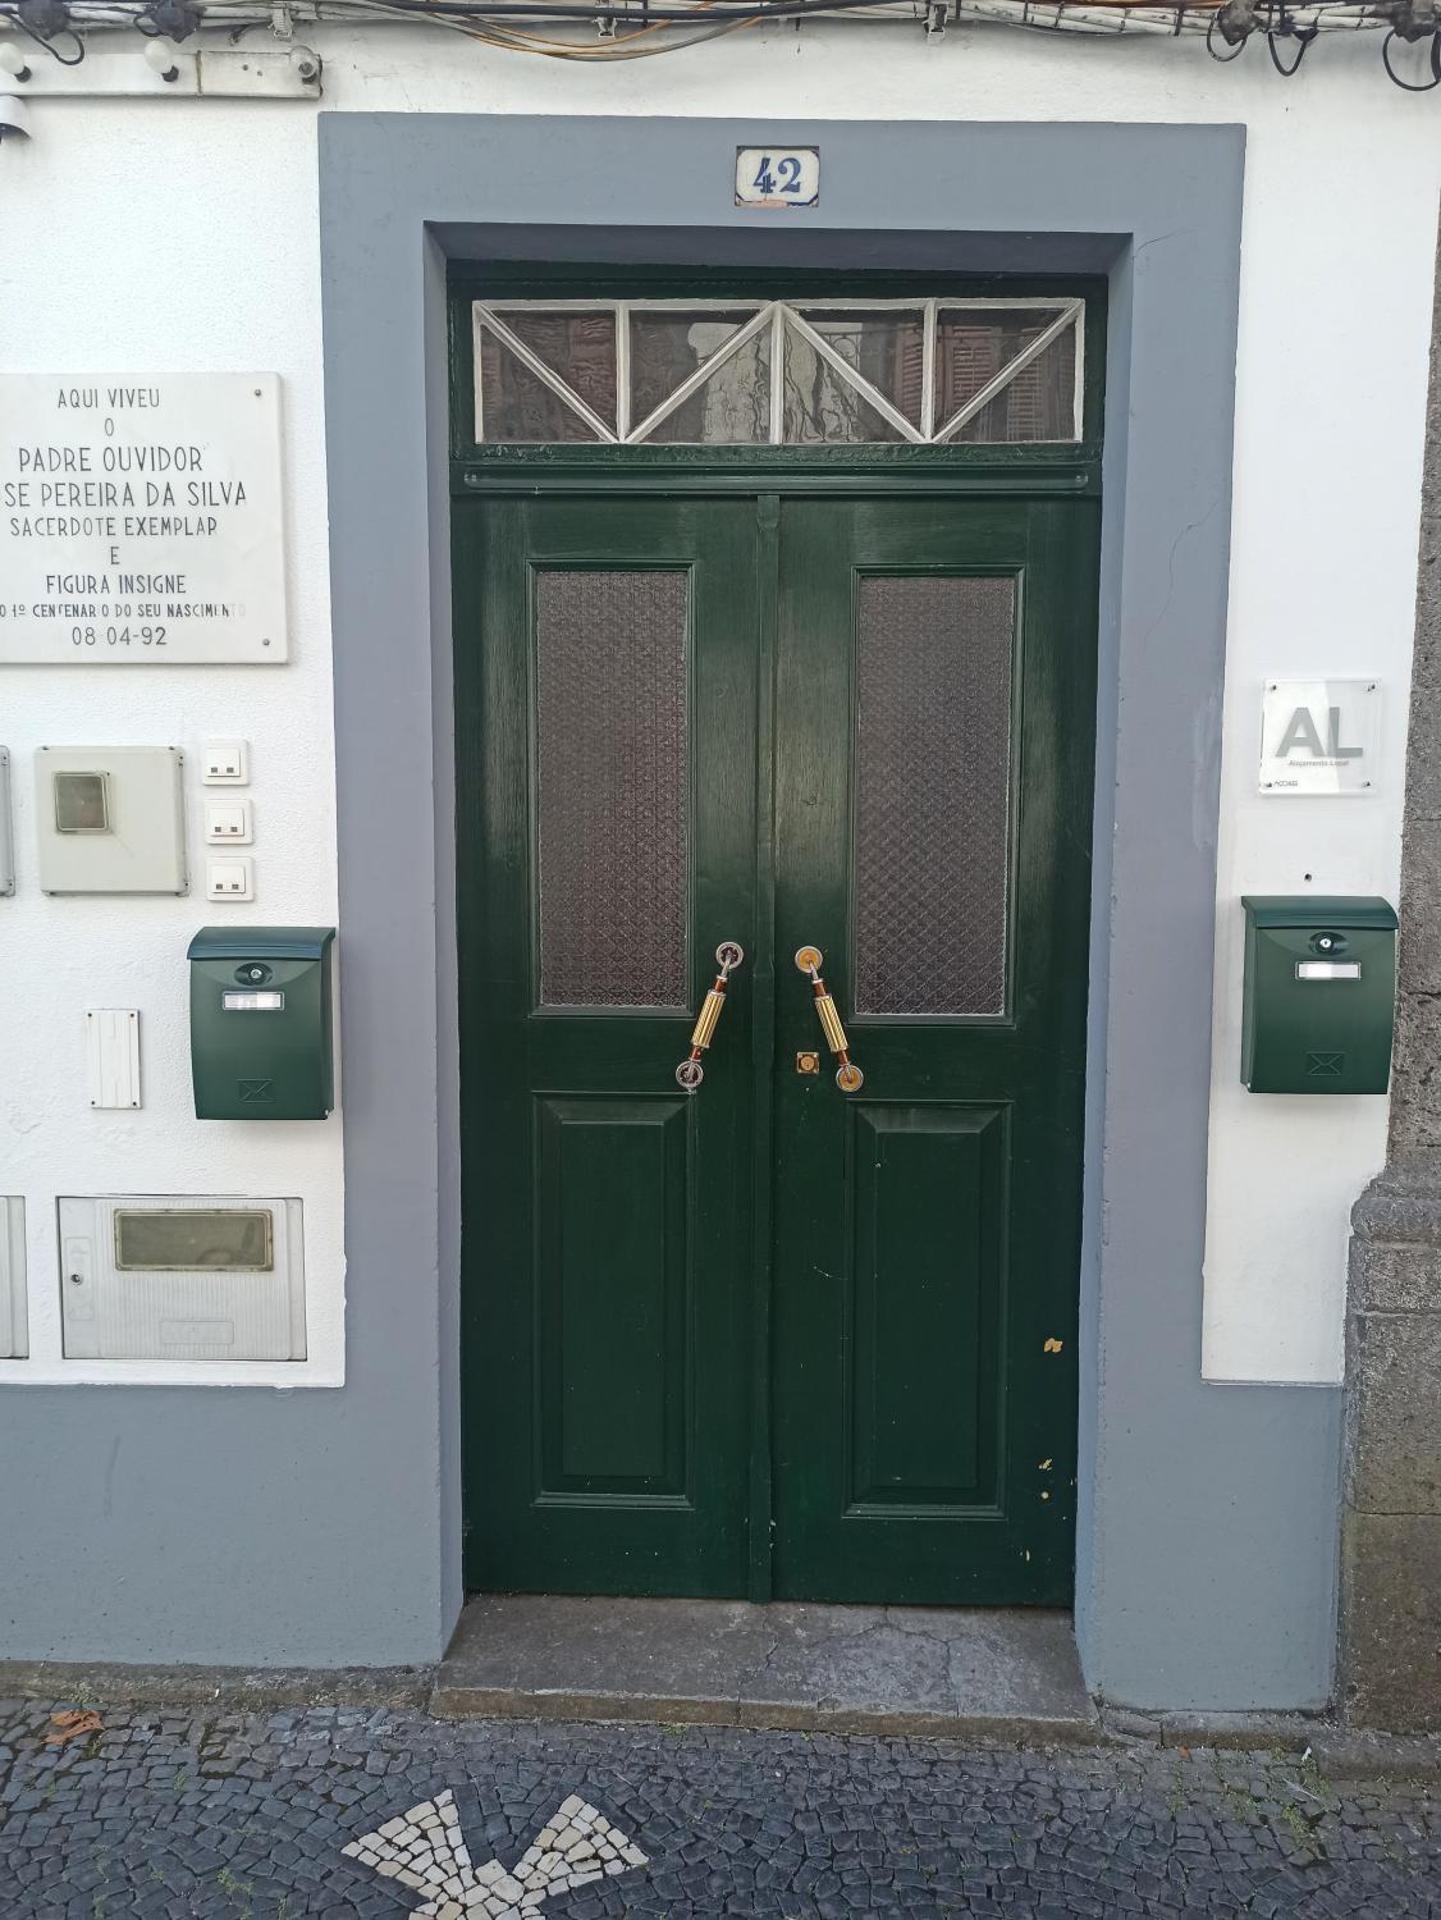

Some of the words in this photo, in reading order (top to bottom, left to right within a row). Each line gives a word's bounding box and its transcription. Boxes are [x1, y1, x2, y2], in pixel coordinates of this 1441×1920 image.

[753, 157, 802, 193] 42
[58, 388, 98, 408] AQUI
[107, 388, 160, 408] VIVEU
[104, 417, 115, 437] O
[19, 447, 92, 472] PADRE
[103, 446, 202, 471] OUVIDOR
[41, 482, 134, 507] PEREIRA
[146, 481, 175, 507] DA
[187, 481, 246, 506] SILVA
[10, 516, 116, 537] SACERDOTE
[110, 546, 120, 565] E
[46, 574, 110, 594] FIGURA
[119, 574, 187, 594] INSIGNE
[115, 603, 132, 618] DO
[137, 603, 161, 618] SEU
[1274, 706, 1364, 758] AL
